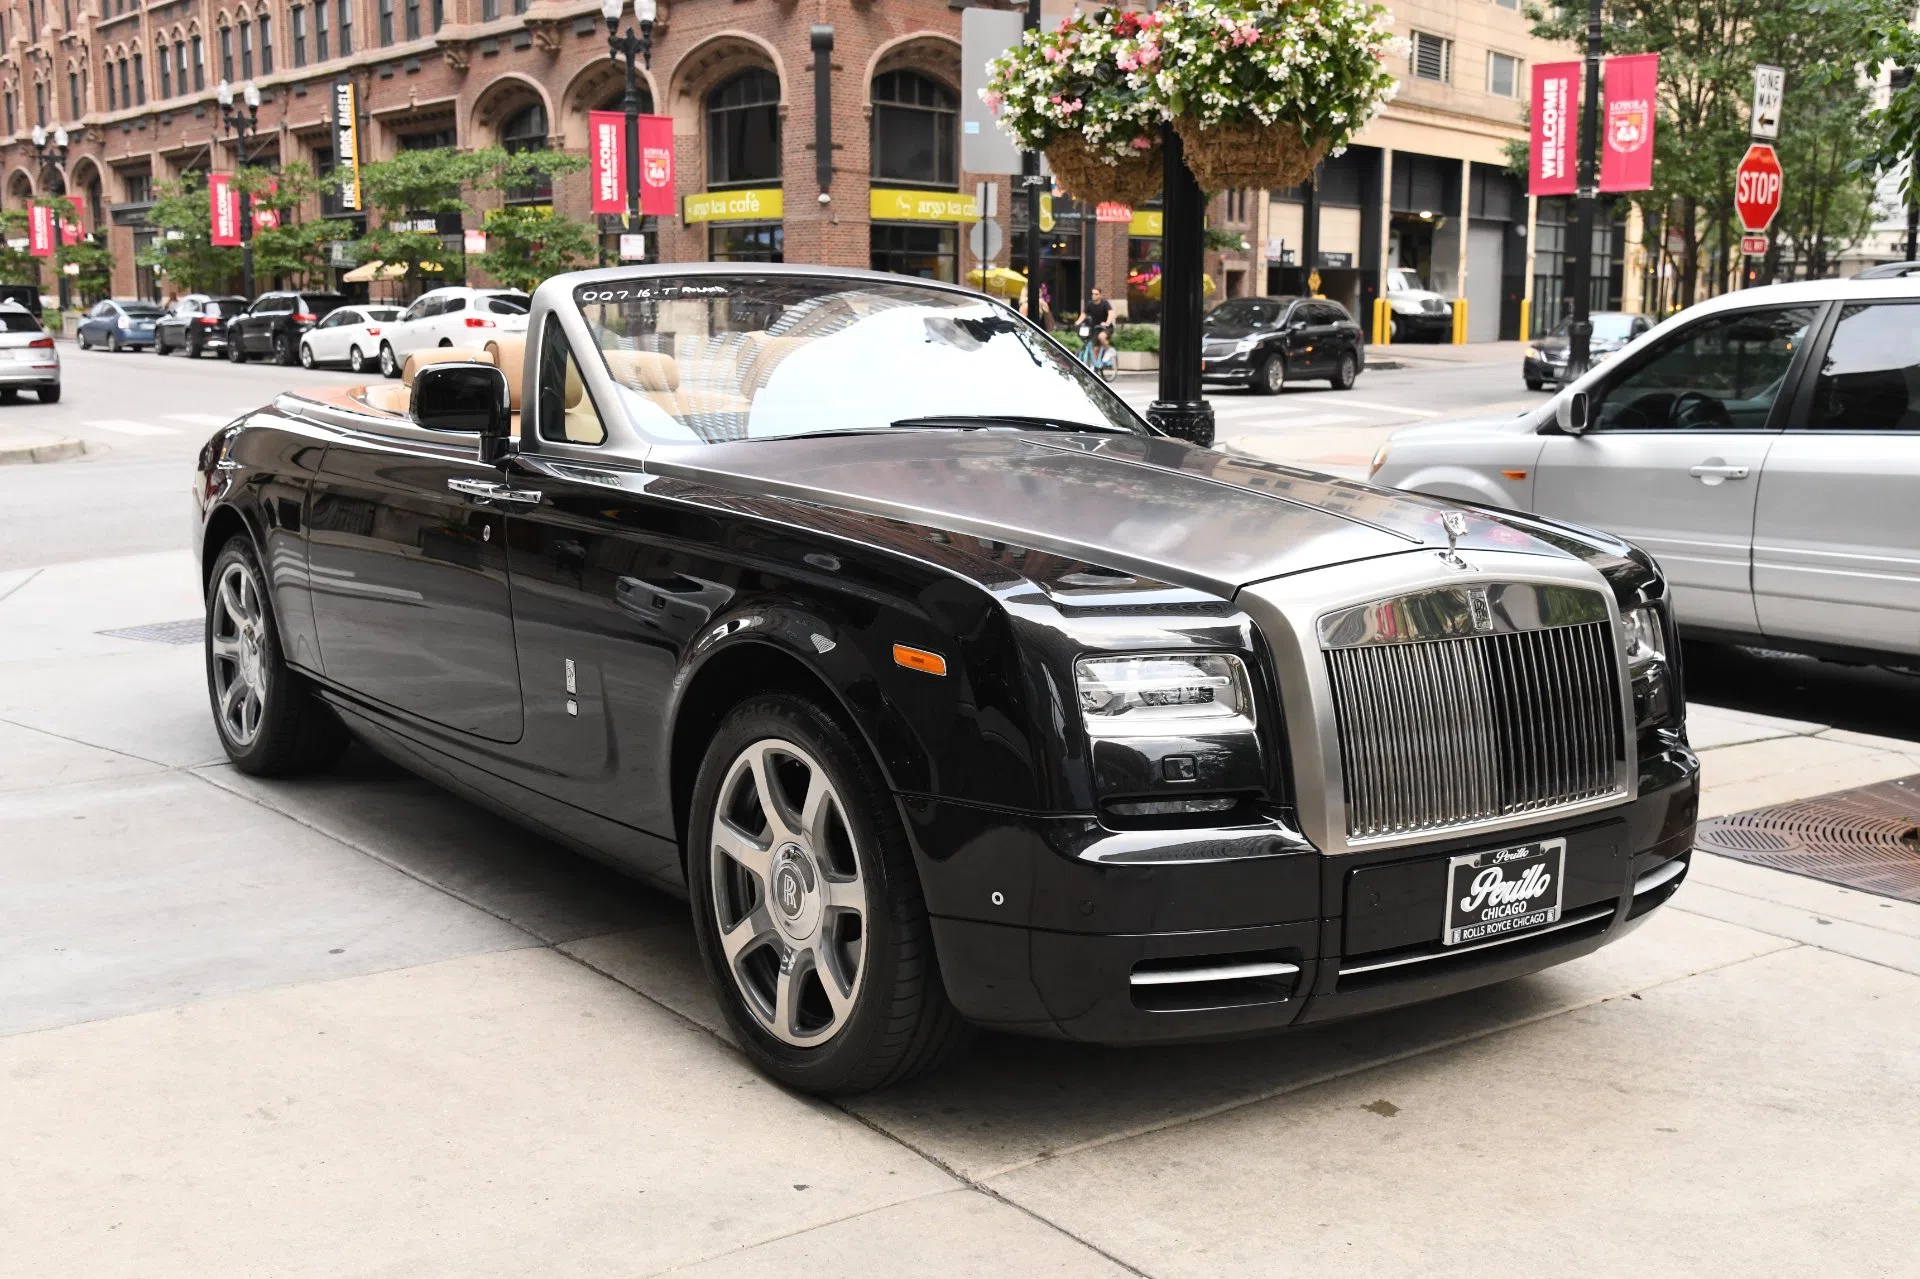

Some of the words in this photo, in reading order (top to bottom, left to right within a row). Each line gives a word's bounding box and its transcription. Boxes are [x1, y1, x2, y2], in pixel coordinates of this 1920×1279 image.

[1760, 71, 1780, 91] ONE
[336, 84, 352, 126] BAGELS
[1758, 92, 1780, 109] WAY
[1542, 78, 1559, 179] WELCOME
[599, 123, 612, 201] WELCOME
[341, 160, 356, 208] EINSN
[1738, 171, 1779, 204] STOP
[217, 183, 228, 237] WELCOME
[729, 190, 760, 213] café
[917, 200, 945, 219] argo
[947, 200, 961, 215] tea
[963, 196, 978, 217] caf
[1460, 863, 1551, 912] Perillo
[1463, 924, 1485, 939] ROLLS
[1486, 919, 1511, 934] ROYCE
[1512, 912, 1545, 928] CHICAGO
[1481, 901, 1527, 920] CHICAGO
